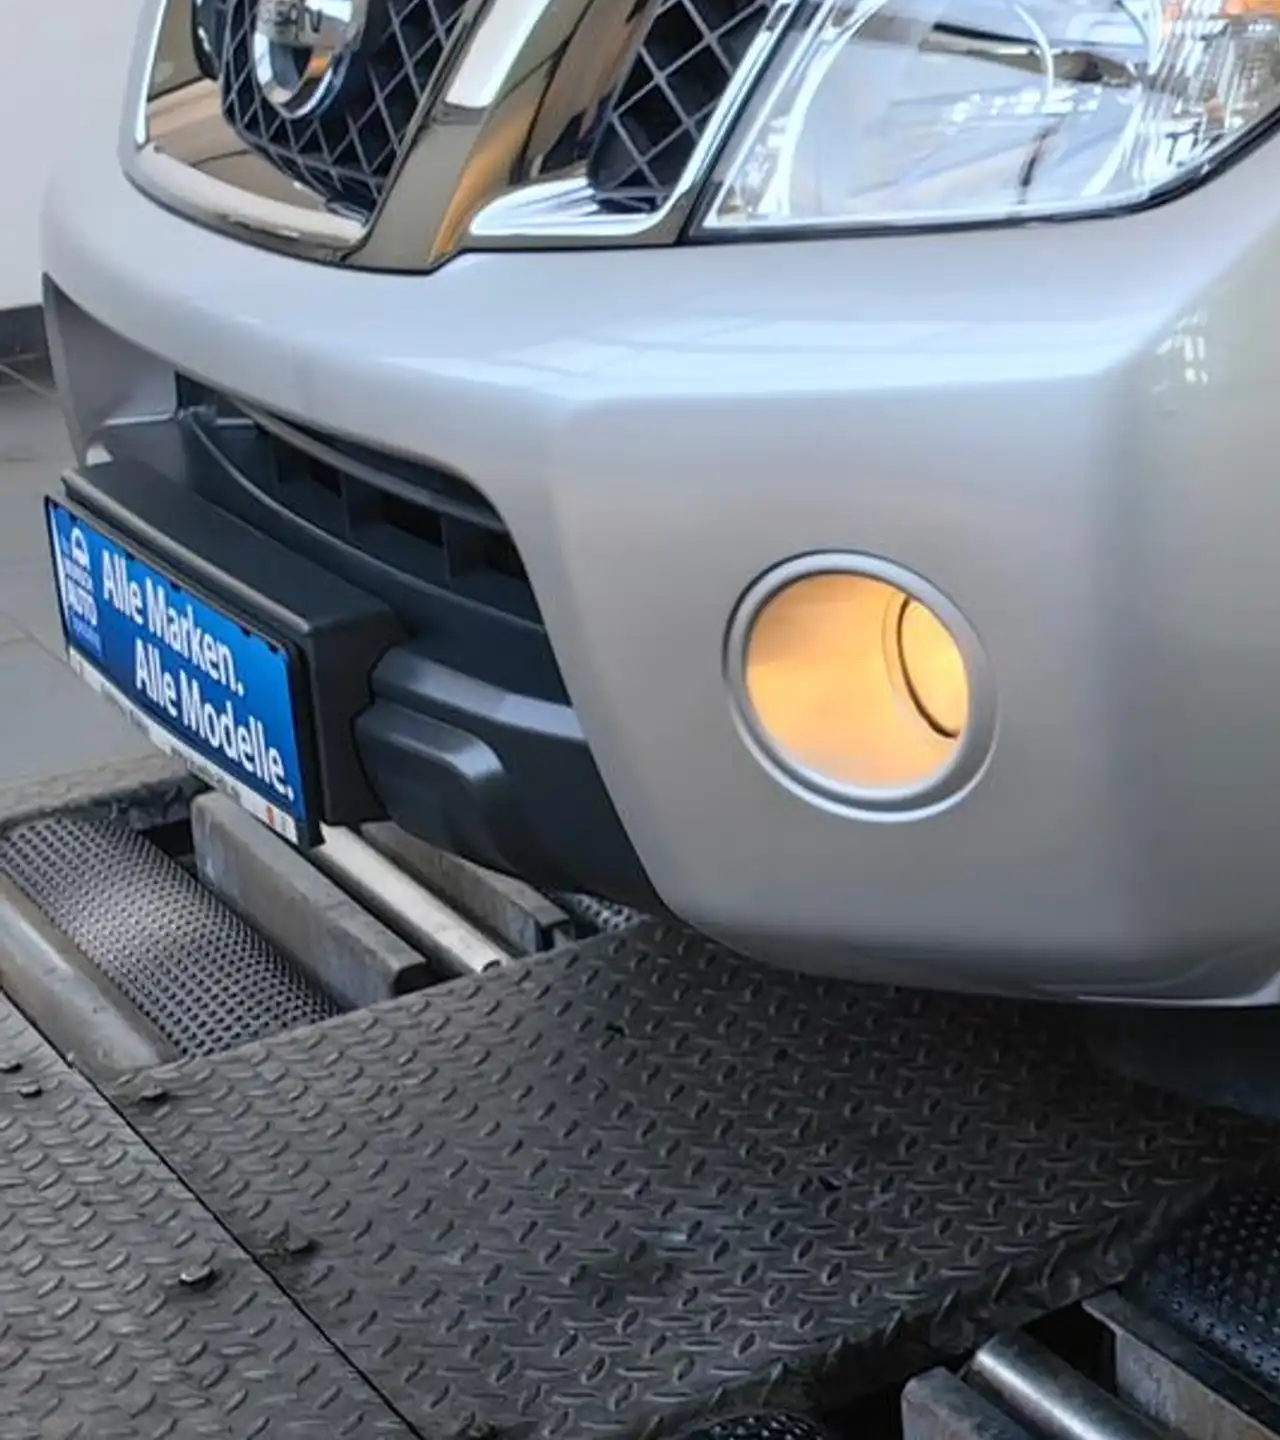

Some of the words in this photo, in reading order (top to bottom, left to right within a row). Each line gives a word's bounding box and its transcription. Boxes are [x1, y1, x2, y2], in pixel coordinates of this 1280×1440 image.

[102, 549, 144, 625] Alle
[147, 577, 245, 697] Marken.
[134, 638, 178, 718] Alle
[180, 672, 295, 802] Modelle.
